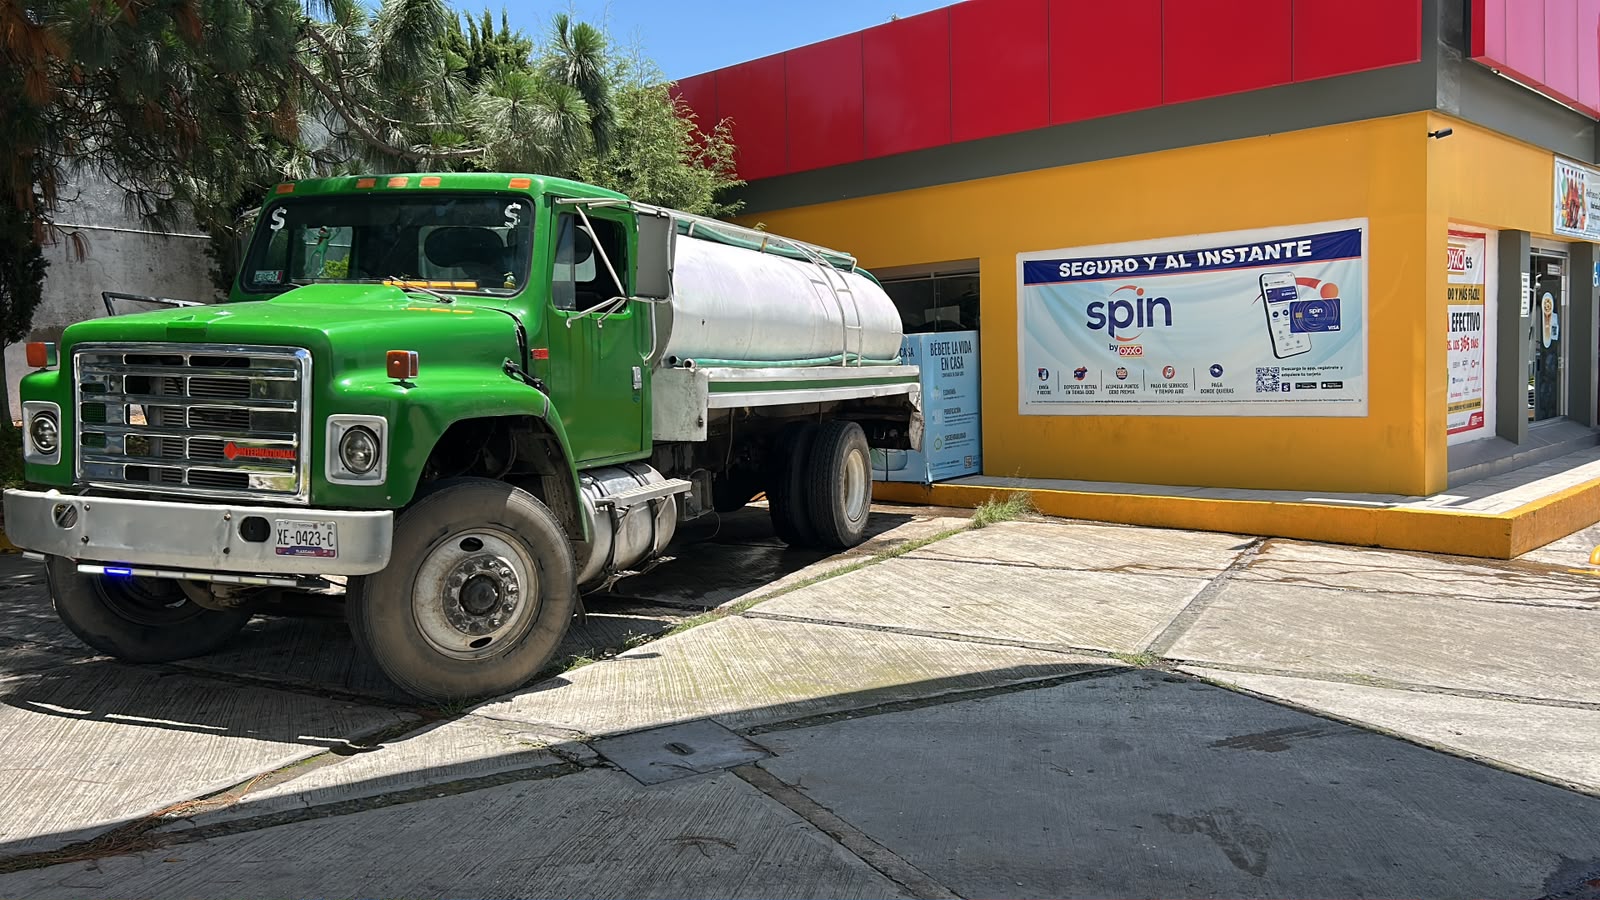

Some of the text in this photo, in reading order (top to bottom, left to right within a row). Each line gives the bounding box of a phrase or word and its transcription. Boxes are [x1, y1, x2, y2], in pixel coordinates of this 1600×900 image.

[1059, 240, 1312, 278] SEGURO Y AL INSTANTE
[1466, 256, 1472, 268] es
[1455, 288, 1458, 300] Y
[1086, 287, 1172, 338] spin
[1452, 312, 1481, 332] EFECTIVO
[930, 340, 972, 356] BÉBETE LA VIDA
[1109, 344, 1143, 355] by OXXO
[1460, 335, 1470, 352] 365
[899, 347, 914, 358] CASA
[941, 356, 964, 371] EN CASA
[238, 447, 296, 459] INTERNATIONAL
[277, 528, 334, 547] XE-0423-C
